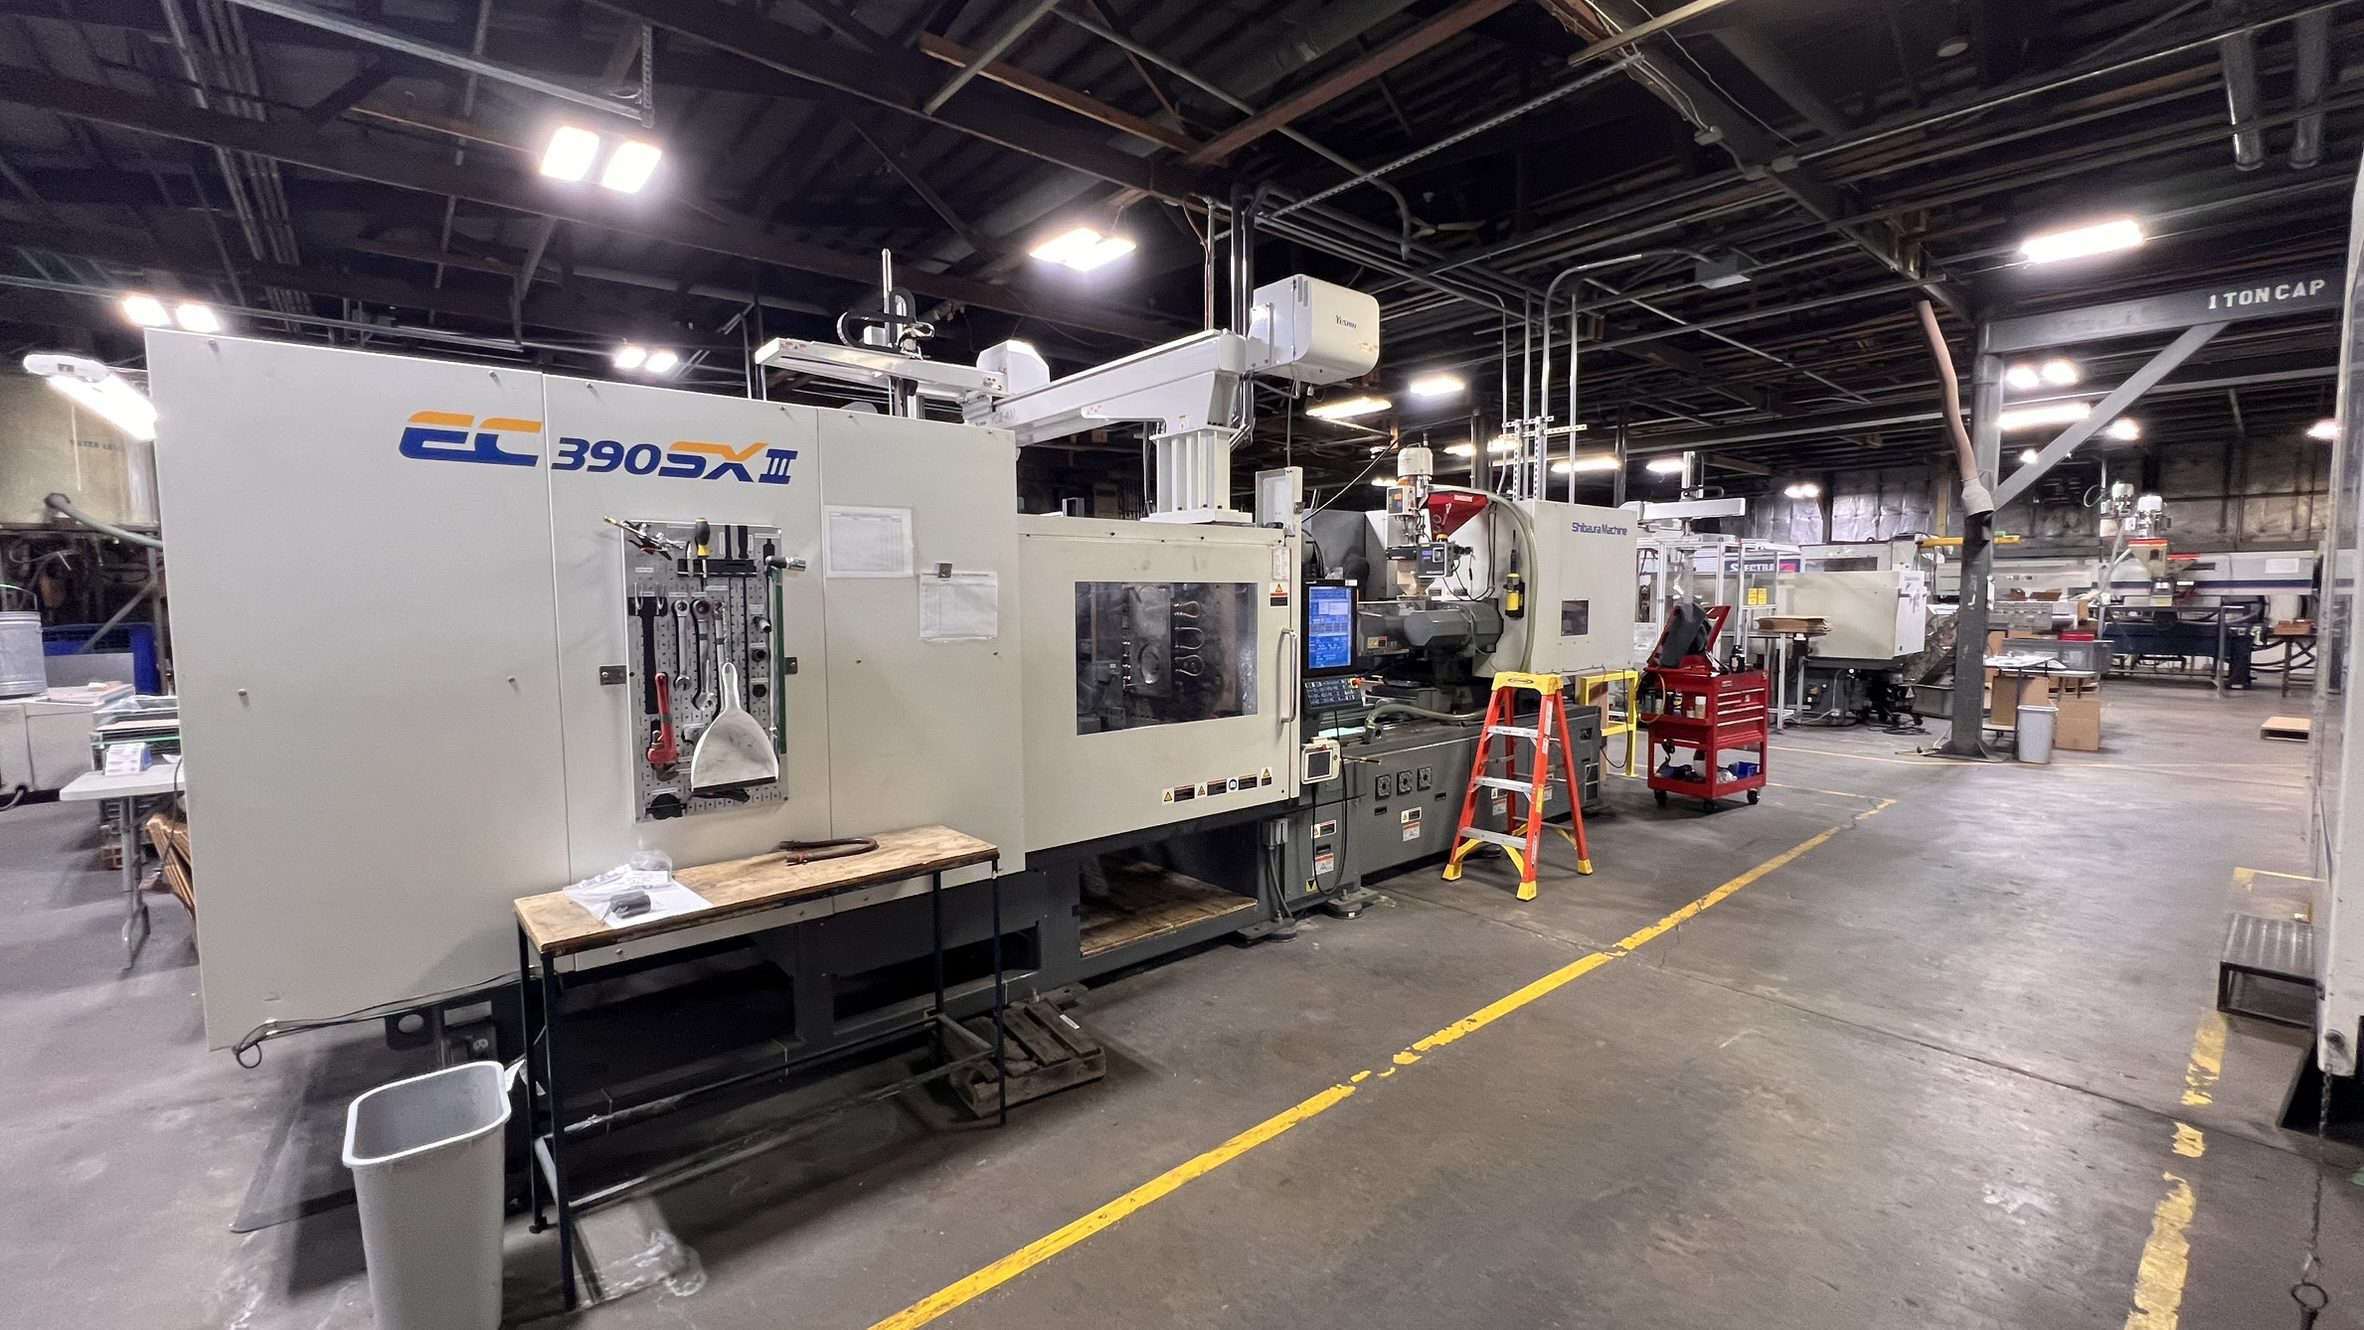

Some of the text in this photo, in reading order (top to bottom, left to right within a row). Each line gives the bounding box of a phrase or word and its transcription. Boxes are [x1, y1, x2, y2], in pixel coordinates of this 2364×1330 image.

[2208, 279, 2326, 310] 1 TON CAP
[399, 410, 543, 468] EC
[1572, 522, 1628, 536] Shibaura Machine
[1730, 563, 1775, 572] SECTRA
